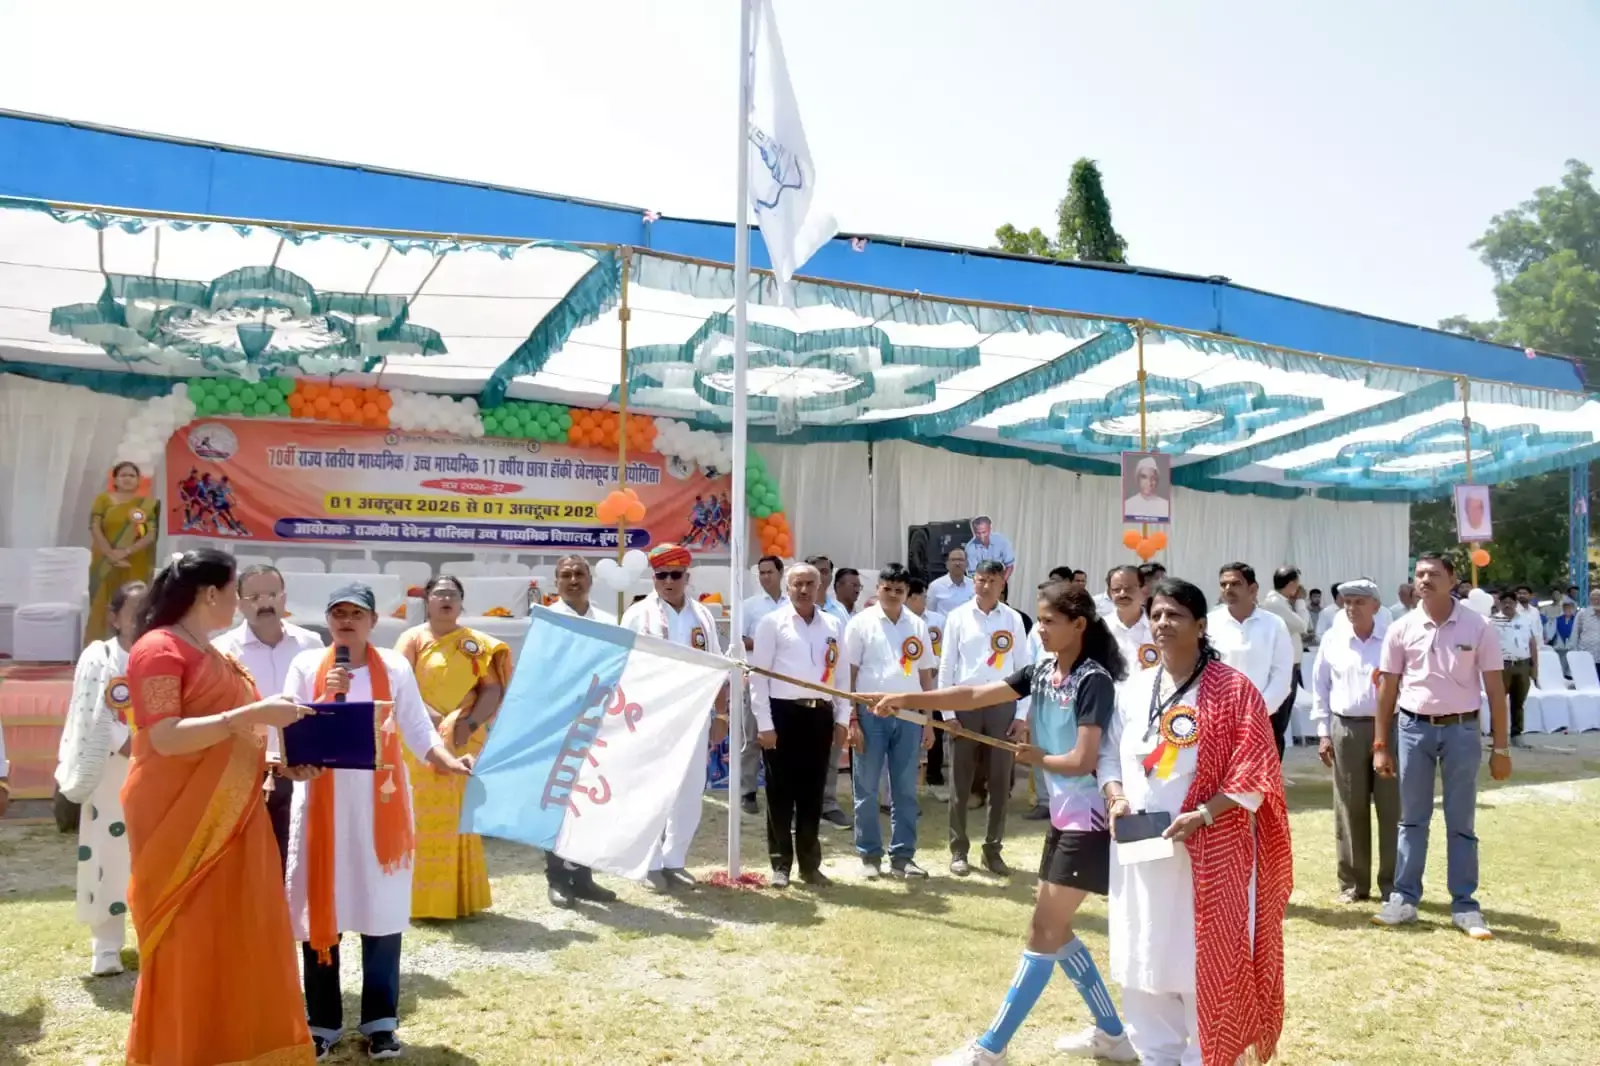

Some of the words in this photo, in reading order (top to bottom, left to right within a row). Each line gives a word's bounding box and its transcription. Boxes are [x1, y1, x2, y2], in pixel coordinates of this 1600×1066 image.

[298, 450, 322, 468] राज्य
[325, 448, 355, 469] स्तरीय
[358, 449, 404, 471] माध्यमिक
[413, 455, 431, 472] उच्च
[434, 452, 479, 474] माध्यमिक
[483, 459, 496, 476] 17
[527, 461, 548, 478] छात्रा
[551, 458, 572, 479] हॉकी
[575, 459, 609, 487] खेलकूद
[330, 496, 352, 509] 01
[358, 498, 412, 514] अक्टूबर
[416, 499, 461, 513] 2026
[466, 498, 478, 513] से
[483, 502, 504, 515] 07
[509, 503, 560, 520] अक्टूबर
[563, 505, 598, 518] 202
[354, 523, 399, 537] राजकीय
[434, 524, 475, 540] बालिका
[500, 528, 549, 542] माध्यमिक
